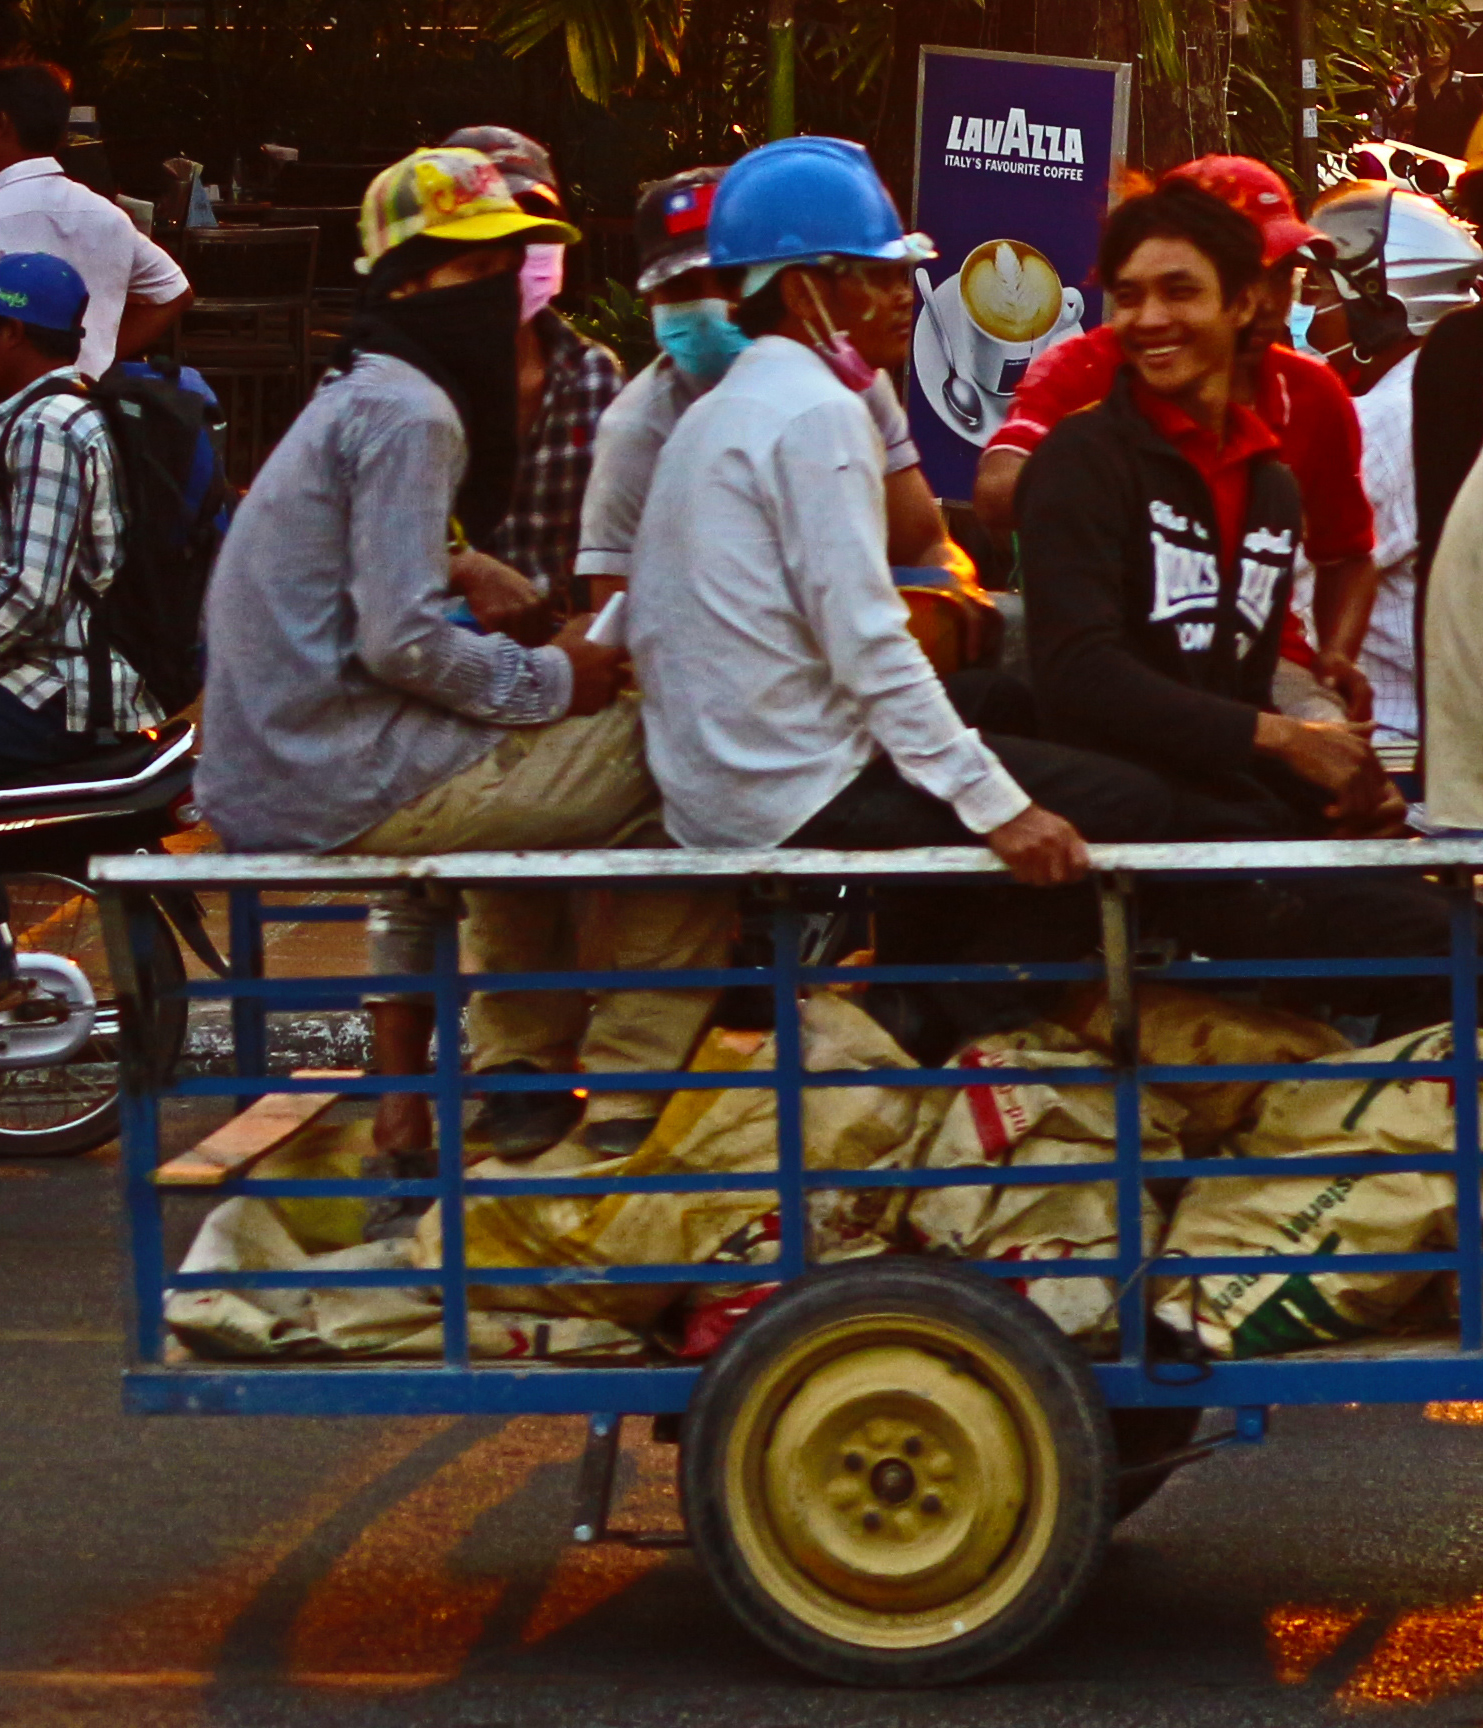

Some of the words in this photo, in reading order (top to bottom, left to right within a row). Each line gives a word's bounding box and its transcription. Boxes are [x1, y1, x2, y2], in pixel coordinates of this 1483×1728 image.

[945, 107, 1085, 164] LAVAZZA
[944, 154, 982, 170] ITALY'S
[985, 158, 1041, 177] FAVOURITE
[1043, 165, 1084, 182] COFFEE
